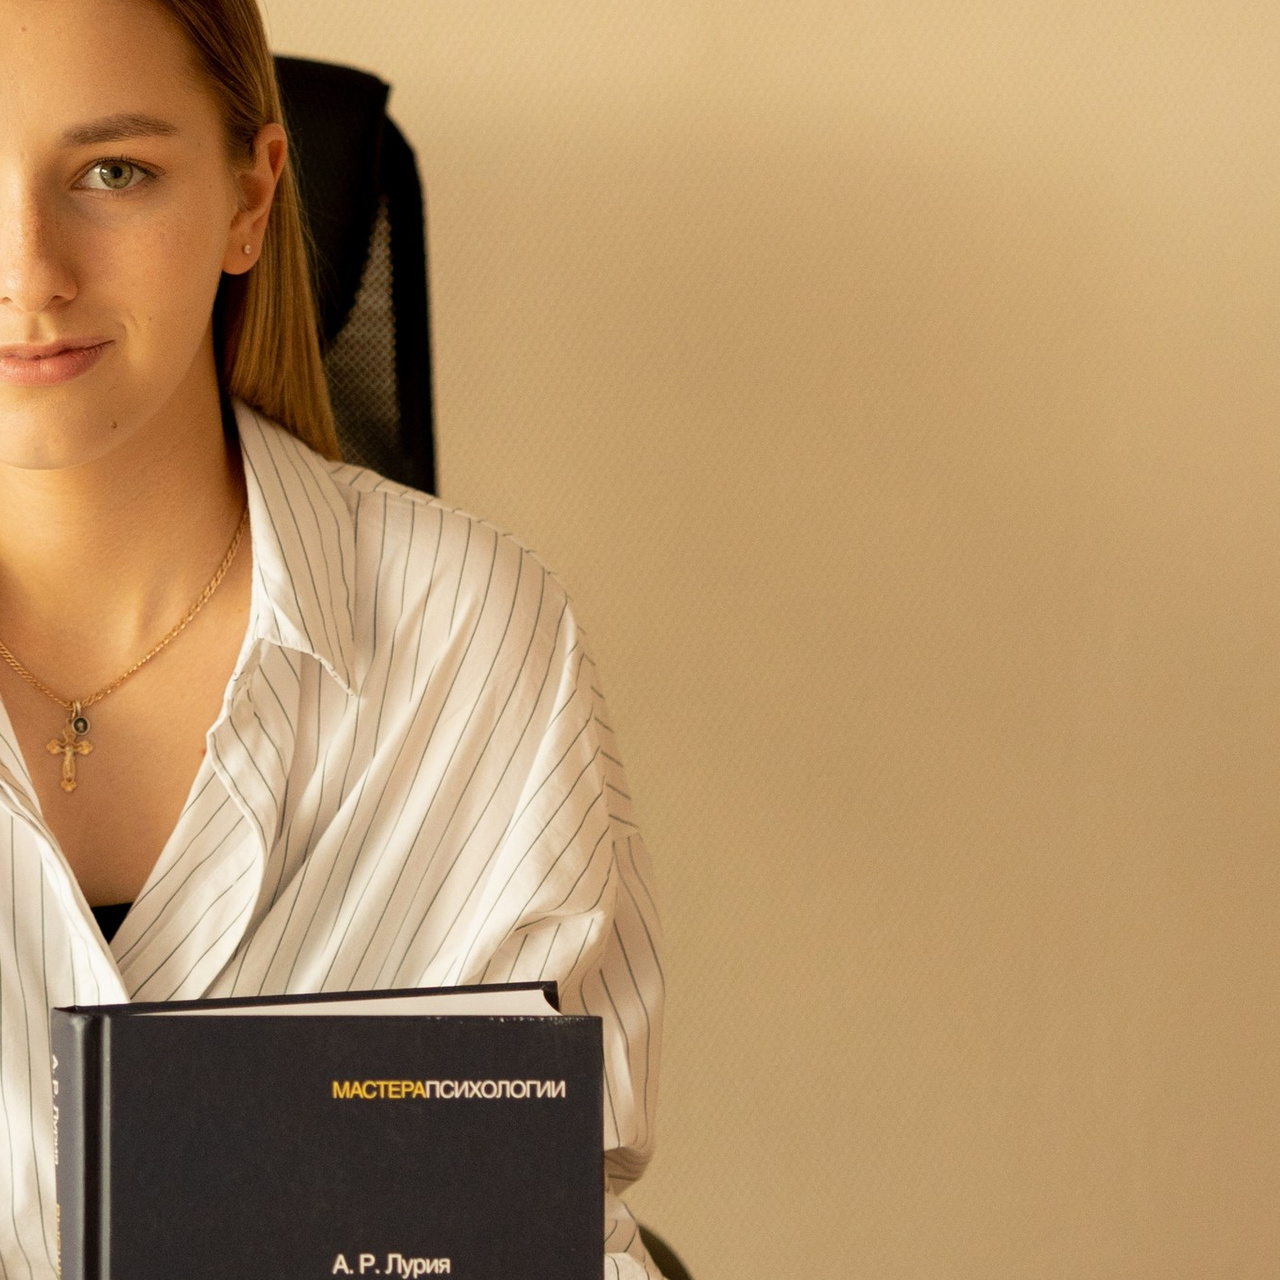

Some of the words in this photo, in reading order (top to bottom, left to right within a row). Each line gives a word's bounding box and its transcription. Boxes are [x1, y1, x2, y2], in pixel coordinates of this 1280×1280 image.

[332, 1253, 354, 1274] А.
[359, 1253, 381, 1274] Р.
[385, 1253, 451, 1279] Лурия
